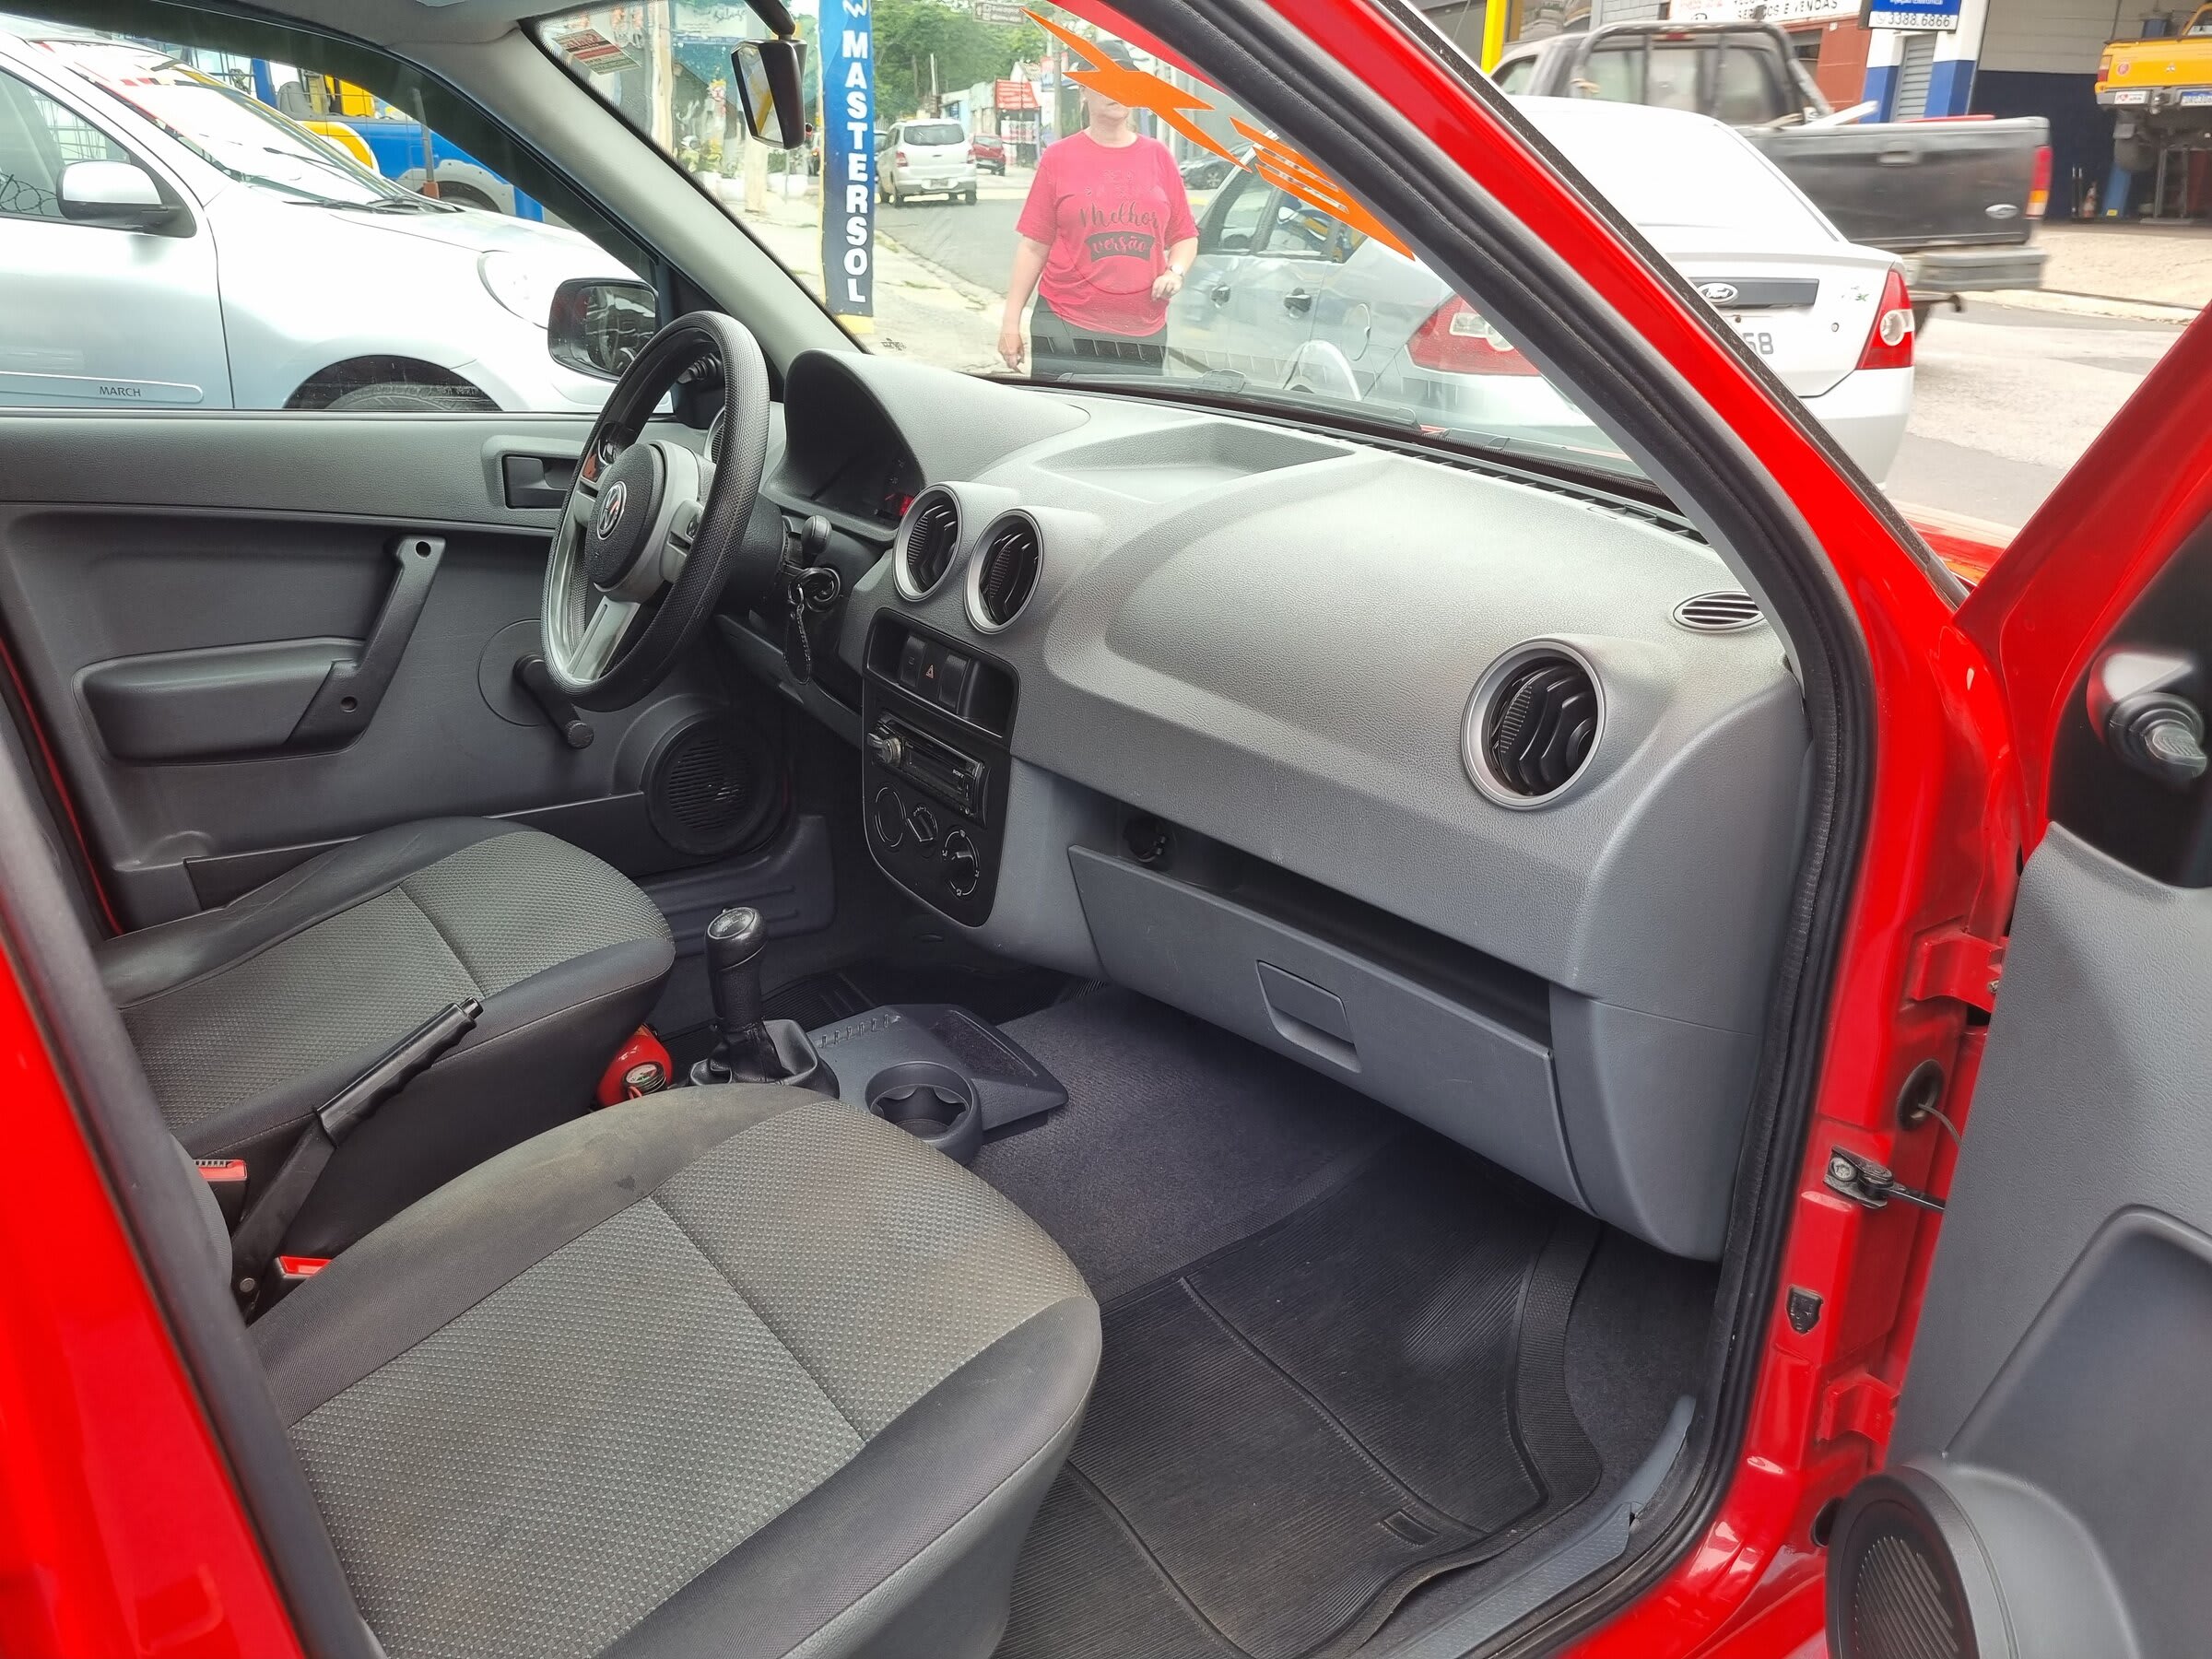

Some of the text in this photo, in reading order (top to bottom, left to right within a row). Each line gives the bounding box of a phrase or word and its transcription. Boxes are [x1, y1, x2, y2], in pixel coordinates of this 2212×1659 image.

[841, 29, 869, 303] MASTERSOL
[1079, 201, 1159, 229] Melhor
[100, 385, 141, 397] MARCH
